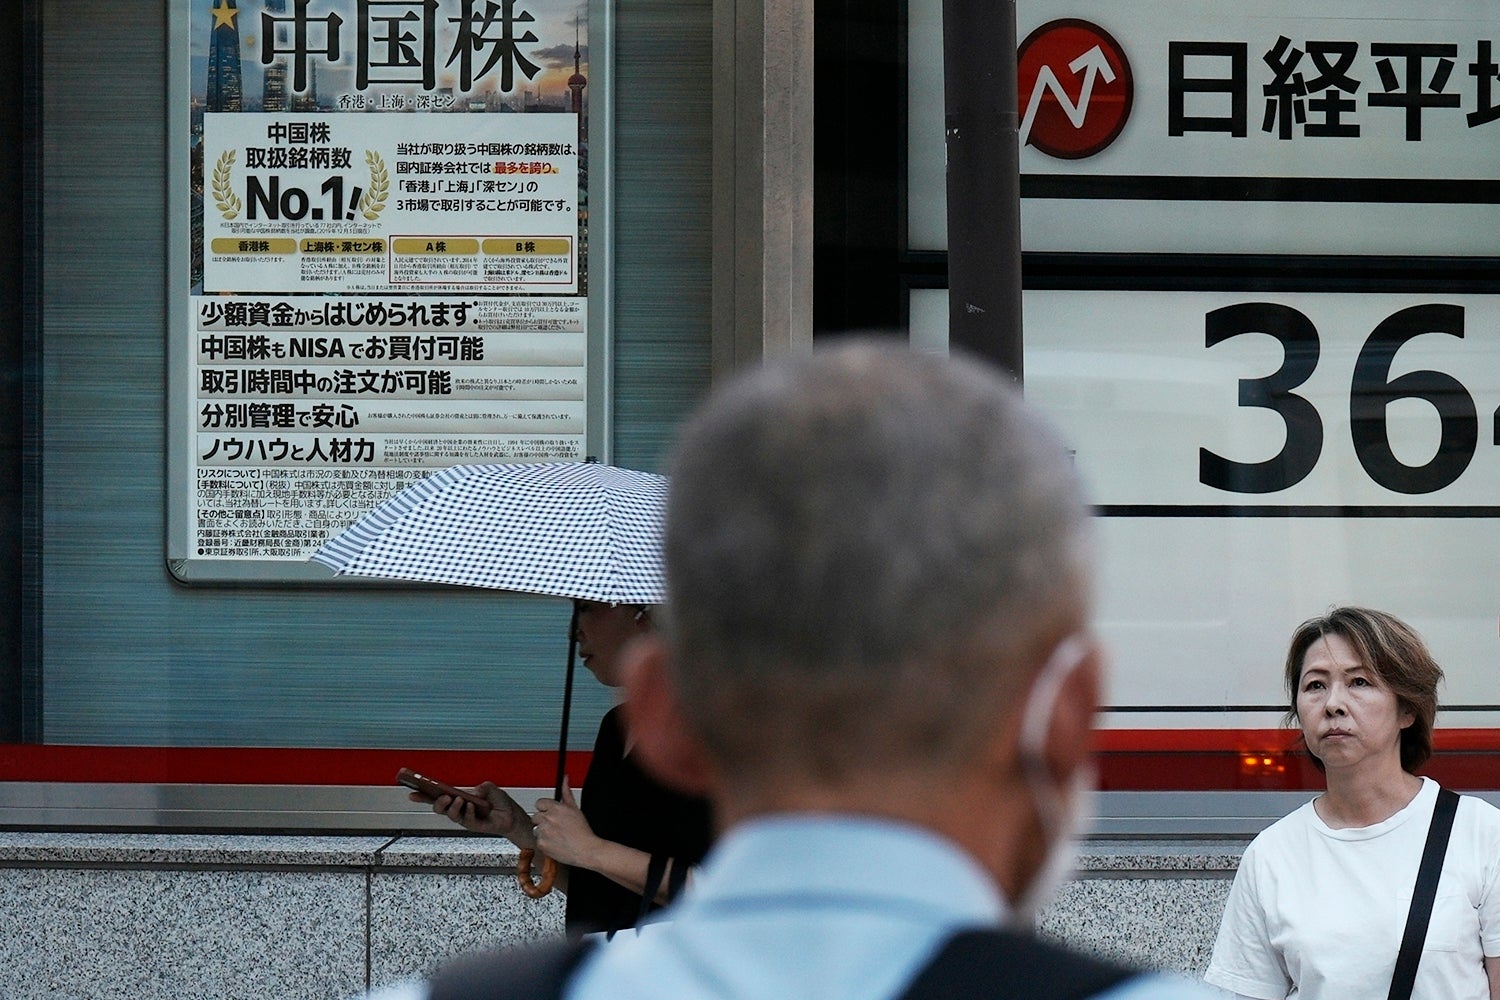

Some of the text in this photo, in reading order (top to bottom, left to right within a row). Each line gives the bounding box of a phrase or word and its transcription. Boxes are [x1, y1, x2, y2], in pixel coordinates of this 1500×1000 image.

[261, 0, 542, 92] 中国株
[339, 95, 457, 110] 香港・上海・深セン
[267, 122, 330, 144] 中国株
[246, 147, 352, 169] 取扱銘柄数
[396, 143, 577, 157] 当社が取り扱う中国株の銘柄数は、
[396, 161, 557, 175] 国内証券会社では 最多を誇り、
[246, 177, 363, 221] No.1!
[396, 198, 573, 213] 3市場で取引することが可能です。
[238, 240, 270, 253] 香港株
[305, 240, 383, 254] 上海株・深セン株
[201, 301, 473, 328] 少額資金からはじめられます
[201, 369, 452, 395] 取引時間中の注文が可能
[201, 403, 359, 428] 分別管理で安心
[201, 437, 375, 462] ノウハウと人材力
